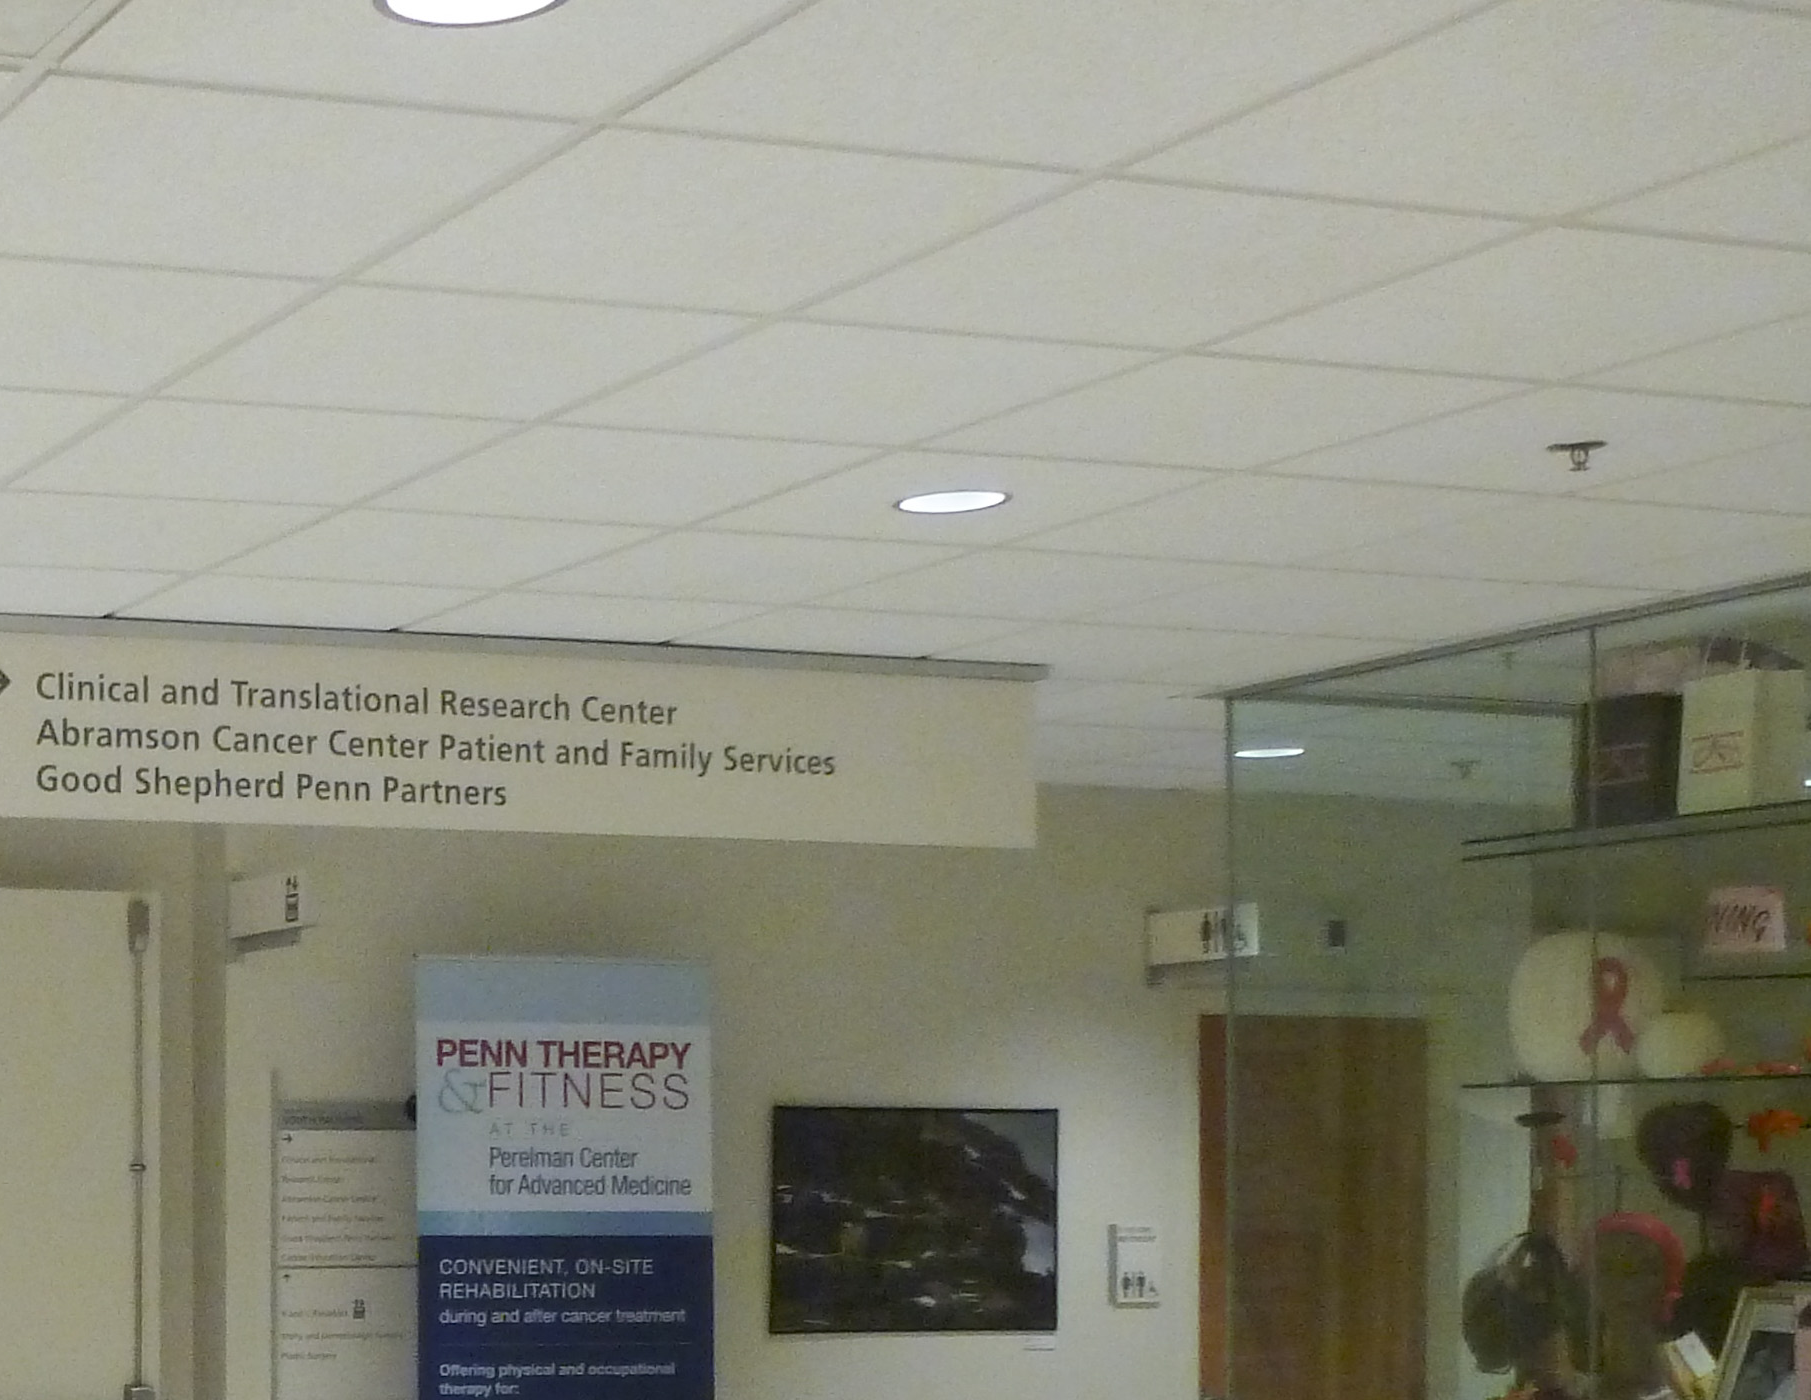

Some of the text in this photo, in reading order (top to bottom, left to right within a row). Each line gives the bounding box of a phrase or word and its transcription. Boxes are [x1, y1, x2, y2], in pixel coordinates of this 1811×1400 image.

[36, 671, 678, 726] Clinical and Translational Research Center
[36, 717, 837, 778] Abramson Cancer Center Patient and Family Services
[37, 763, 508, 806] Good Shepherd Penn Partners
[437, 1039, 692, 1070] PENN THERAPY
[488, 1071, 690, 1110] FITNESS
[489, 1122, 572, 1137] AT THE
[490, 1147, 639, 1168] Perelman Center
[489, 1175, 692, 1197] for Advanced Medicine
[439, 1258, 655, 1277] CONVENIENT, ON-SITE
[439, 1282, 597, 1299] REHABILITATION
[439, 1308, 686, 1327] during and after cancer treatment
[439, 1362, 676, 1379] Offering physical and occupational
[439, 1381, 492, 1398] therapy
